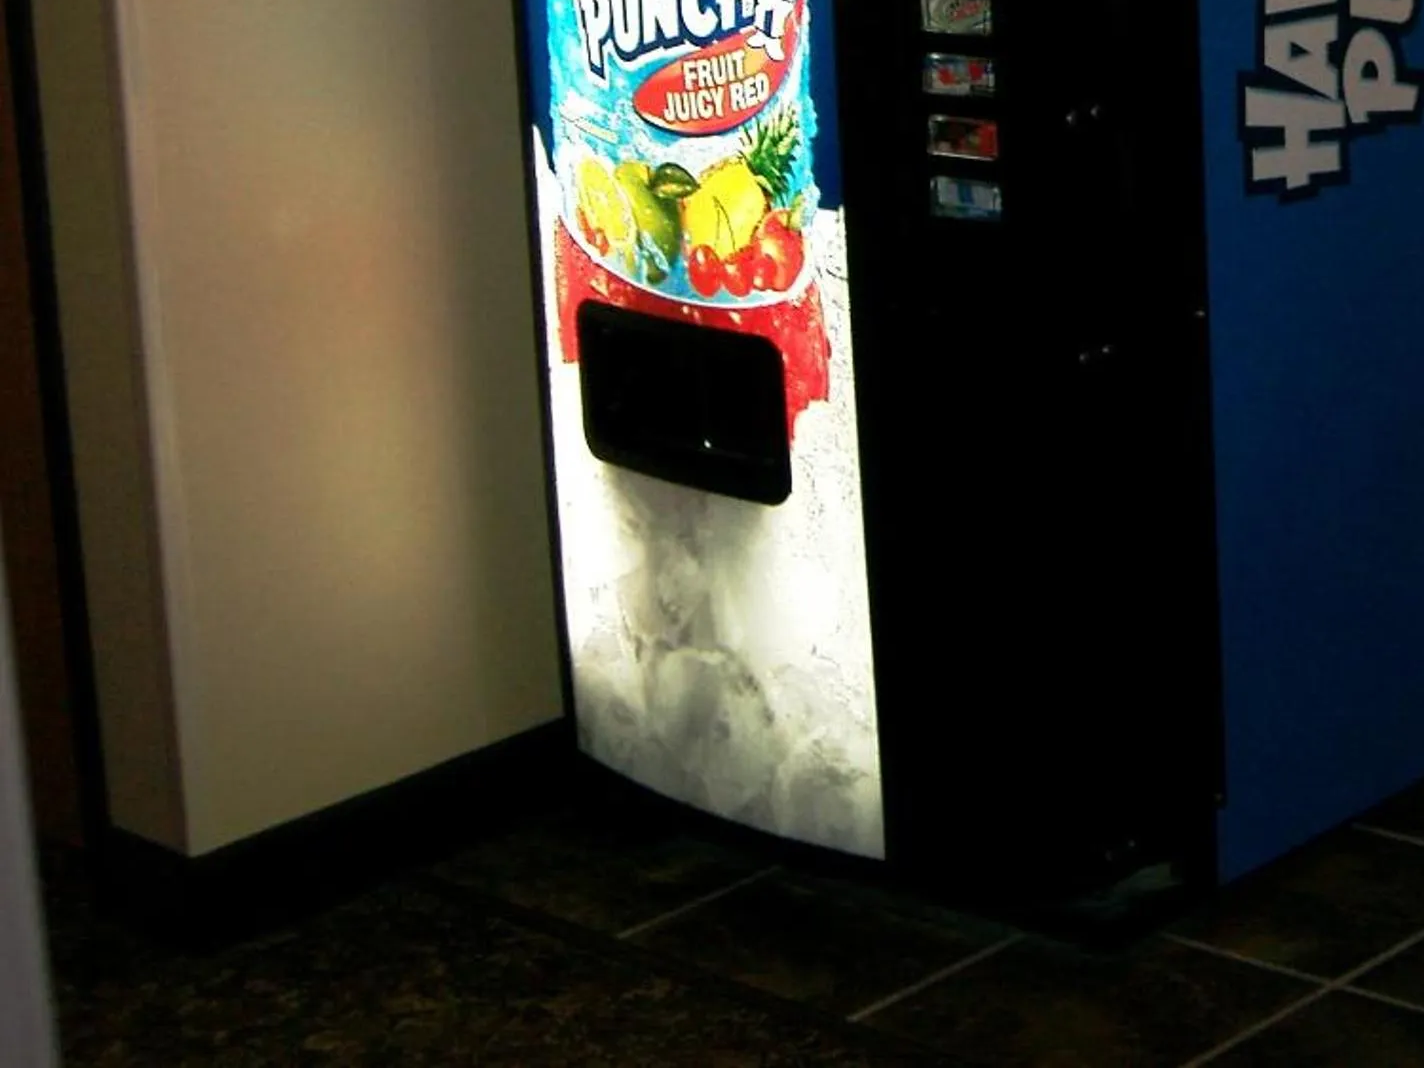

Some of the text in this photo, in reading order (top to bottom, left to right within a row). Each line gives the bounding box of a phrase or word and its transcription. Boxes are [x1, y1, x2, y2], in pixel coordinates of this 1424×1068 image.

[683, 49, 745, 91] FRUIT
[663, 71, 770, 122] JUICY RED
